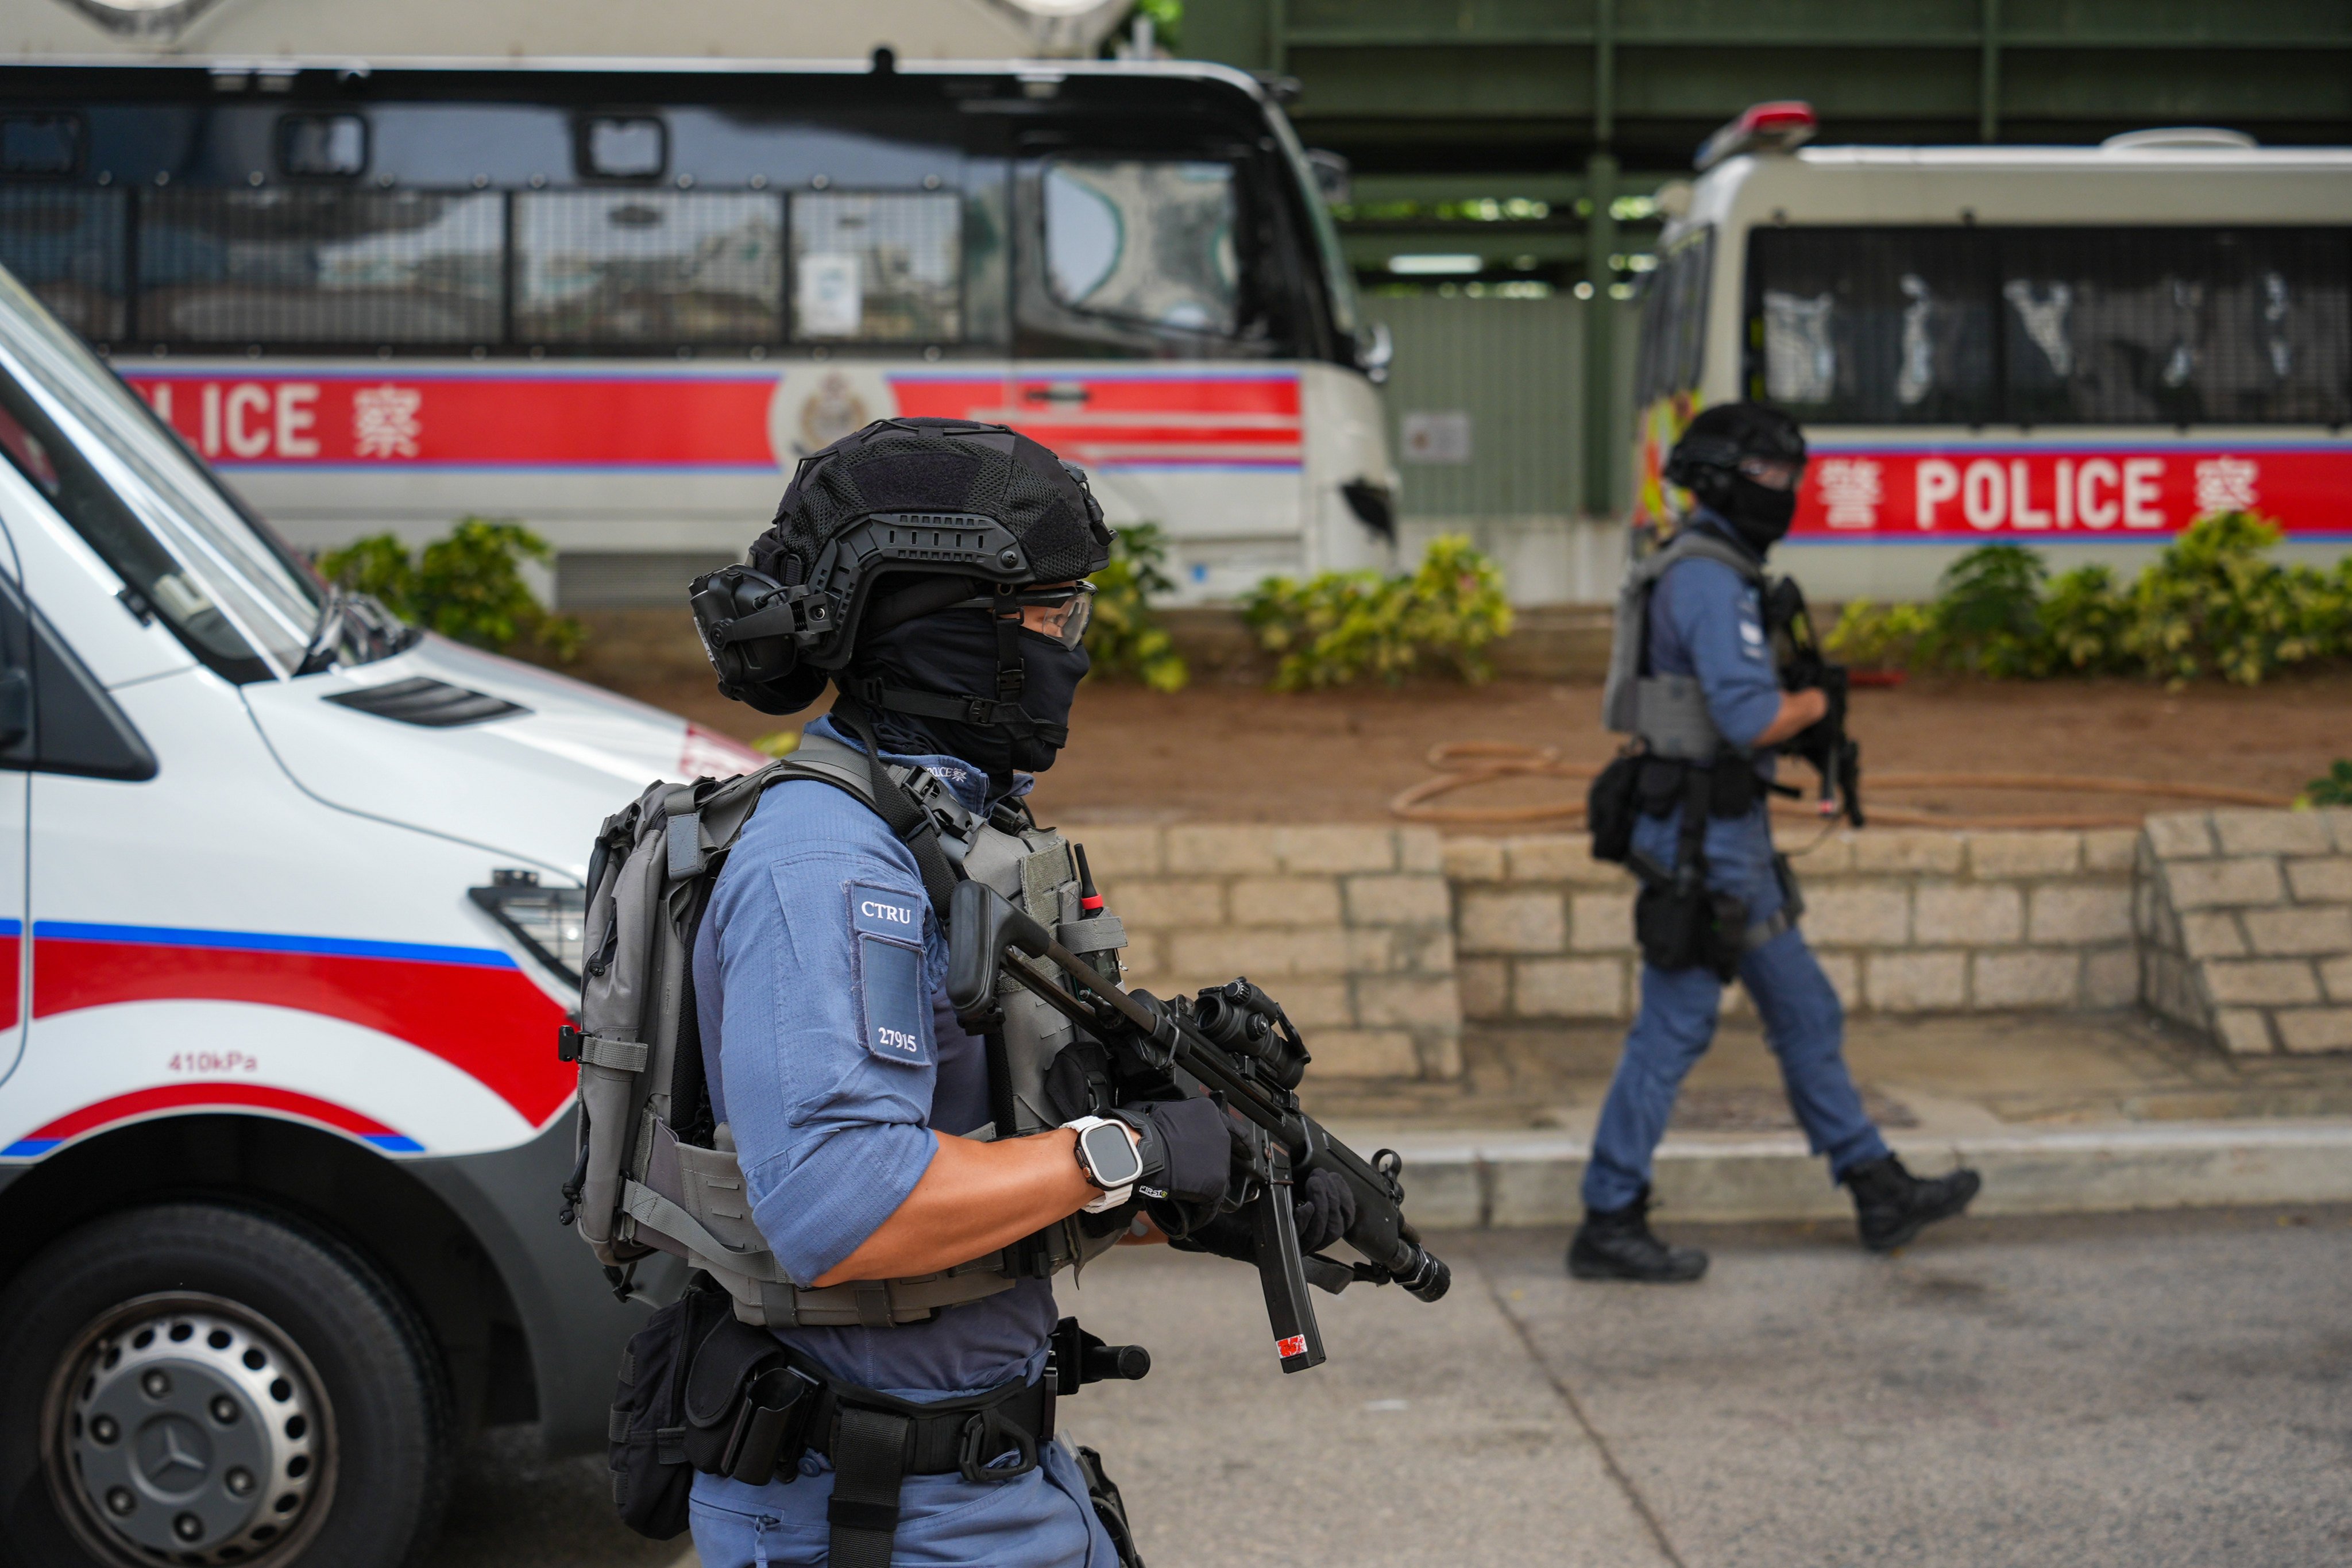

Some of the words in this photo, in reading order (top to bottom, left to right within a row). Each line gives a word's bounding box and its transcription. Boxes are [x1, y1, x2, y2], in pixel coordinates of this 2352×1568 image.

[353, 384, 422, 458] 察
[1817, 457, 1884, 528] 警
[1916, 458, 2166, 530] POLICE
[862, 901, 911, 924] CTRU
[878, 1027, 917, 1052] 27915
[169, 1052, 257, 1072] 410kPa
[1140, 1185, 1163, 1196] FIRST
